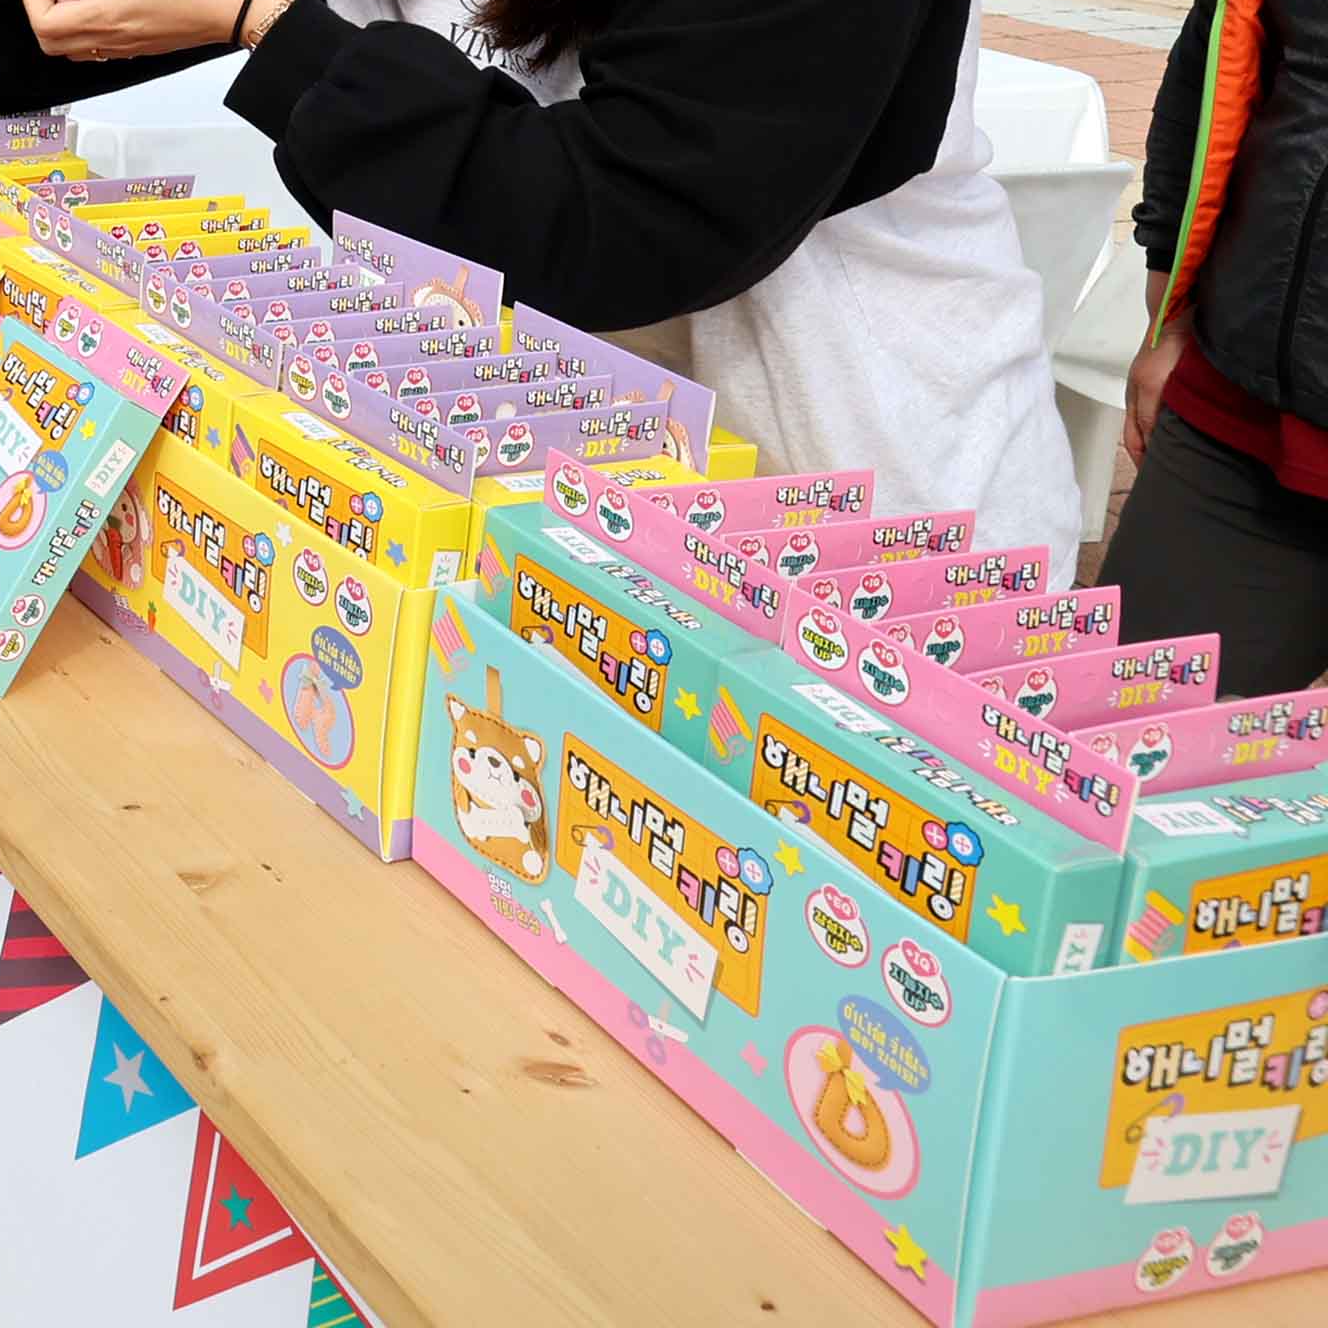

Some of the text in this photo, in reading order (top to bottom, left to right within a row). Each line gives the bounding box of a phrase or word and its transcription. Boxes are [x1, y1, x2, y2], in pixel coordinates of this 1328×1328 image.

[336, 234, 395, 276] 애니멀키링
[2, 276, 50, 331] 애니멀
[218, 317, 275, 369] 애니멀키링
[225, 339, 251, 366] DIY
[125, 347, 176, 399] 애니멀키링
[1, 351, 79, 442] 애니멀키링
[390, 407, 466, 473] 애니멀키링
[579, 410, 661, 441] 애니멀키링
[397, 433, 432, 466] DIY
[584, 437, 621, 458] DIY
[96, 453, 128, 491] DIY
[259, 452, 375, 561] 애니멀키링
[776, 478, 865, 513] 애니멀키링
[784, 508, 824, 527] DIY
[873, 519, 966, 553] 애니멀키링
[31, 499, 102, 587] 애니멀키링
[156, 485, 269, 615] 애니멀키링
[685, 533, 782, 620] 애니멀키링
[692, 571, 736, 607] DIY
[945, 555, 1041, 591] 애니멀키링
[177, 575, 226, 635] DIY
[1016, 596, 1113, 634] 애니멀키링
[517, 569, 662, 714] 애니멀키링
[813, 645, 833, 663] UP
[1023, 631, 1069, 657] DIY
[1112, 647, 1211, 684] 애니멀키링
[872, 679, 892, 697] UP
[1118, 683, 1164, 709] DIY
[1228, 702, 1328, 740] 애니멀키링
[982, 703, 1120, 819] 애니멀키링
[995, 744, 1057, 796] DIY
[1232, 738, 1280, 765] DIY
[761, 734, 967, 921] 애니멀키링
[567, 750, 759, 954] 애니멀키링
[601, 868, 687, 967] DIY
[812, 905, 863, 953] 감성지수
[825, 933, 848, 955] UP
[905, 944, 934, 971] +IQ
[888, 960, 943, 1013] 지능지수
[902, 987, 927, 1013] UP
[1163, 1126, 1270, 1177] DIY
